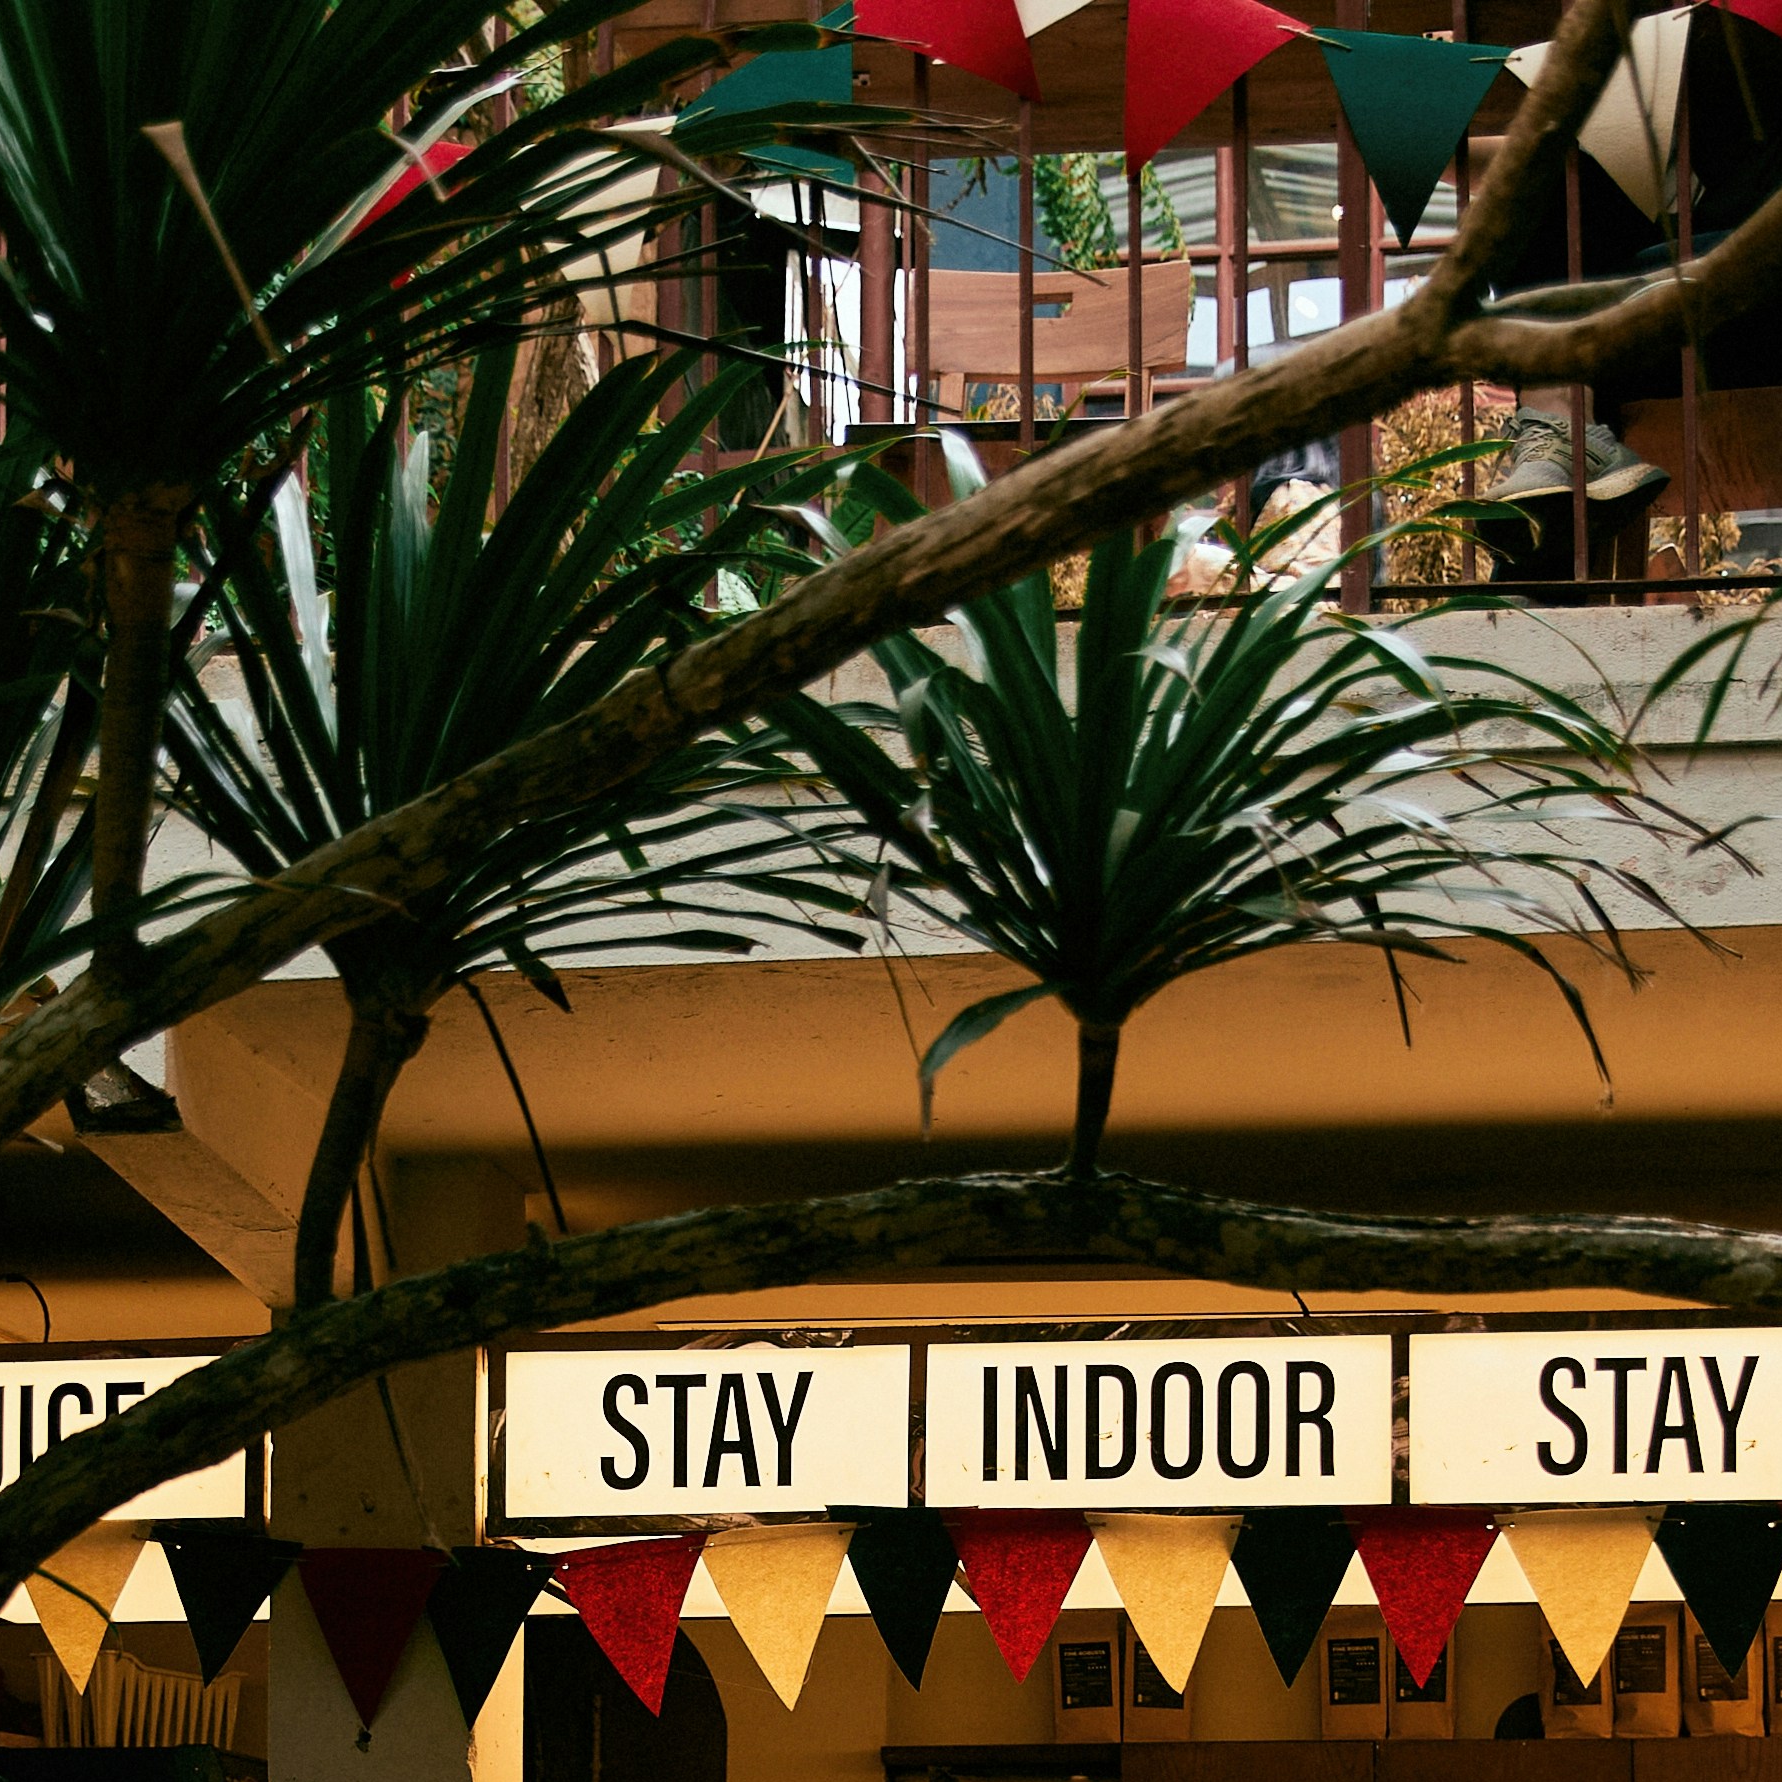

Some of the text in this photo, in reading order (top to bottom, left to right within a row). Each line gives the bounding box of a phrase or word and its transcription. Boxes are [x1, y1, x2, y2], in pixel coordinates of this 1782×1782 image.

[600, 1360, 1336, 1490] STAY INDOOR
[1536, 1355, 1759, 1476] STAY
